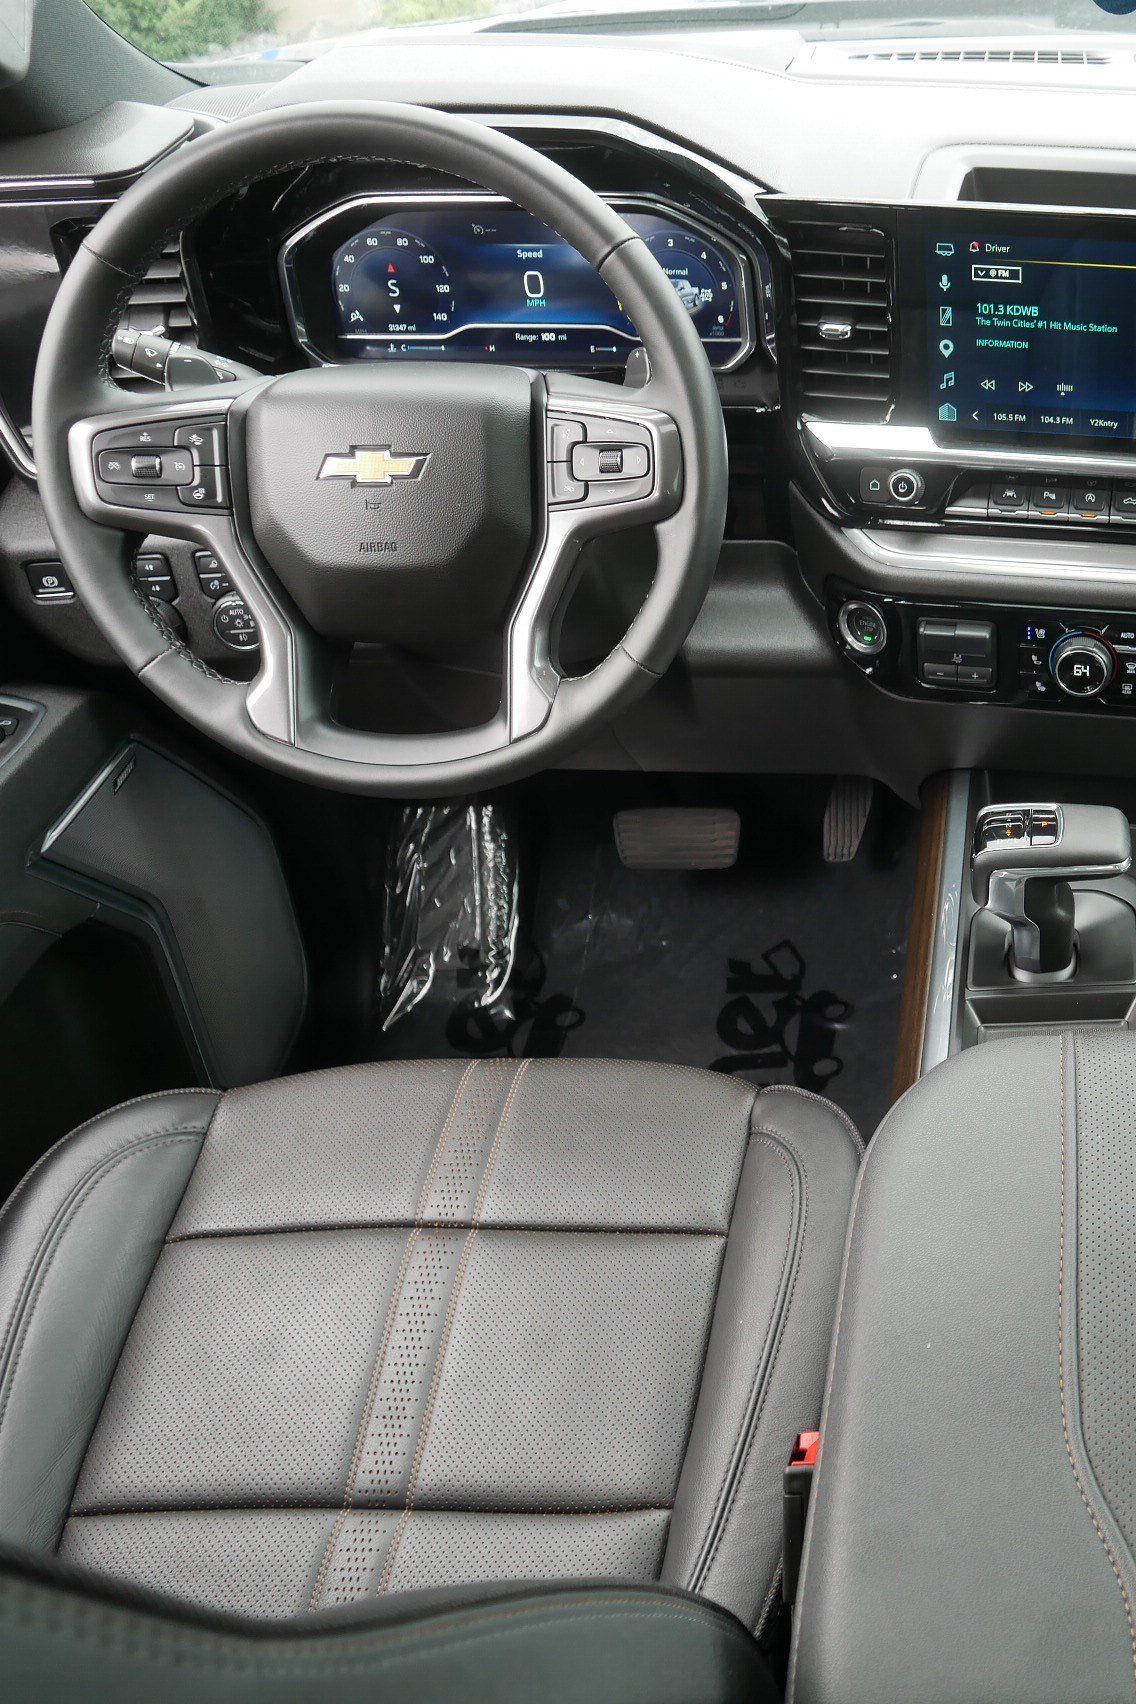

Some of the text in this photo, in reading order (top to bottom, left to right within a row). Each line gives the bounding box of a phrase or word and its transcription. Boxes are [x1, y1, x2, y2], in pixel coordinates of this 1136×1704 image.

[366, 237, 379, 246] 60
[396, 237, 409, 246] 80
[667, 238, 674, 247] 3
[985, 243, 1011, 254] Driver
[343, 255, 355, 263] 40
[419, 255, 435, 264] 100
[516, 249, 543, 260] Speed
[700, 251, 707, 260] 4
[997, 269, 1010, 278] FM
[338, 284, 350, 293] 20
[387, 279, 400, 298] S
[435, 284, 451, 293] 120
[523, 270, 545, 298] 0
[526, 298, 547, 308] MPH
[976, 302, 1039, 317] 101.3 KDWB
[432, 312, 448, 322] 140
[975, 316, 992, 327] The
[992, 317, 1011, 328] Twin
[1037, 320, 1048, 328] #1
[1049, 320, 1062, 330] Hit
[1063, 321, 1088, 332] Music
[1088, 323, 1118, 333] Station
[515, 332, 567, 343] Range: 100 mi
[976, 338, 1029, 349] INFORMATION
[1013, 413, 1027, 422] FM
[1040, 415, 1074, 425] 104.3 FM
[1089, 418, 1118, 430] Y2Kntry
[359, 541, 398, 553] AIRBAG
[229, 608, 244, 616] AUTO
[1073, 664, 1090, 677] 64
